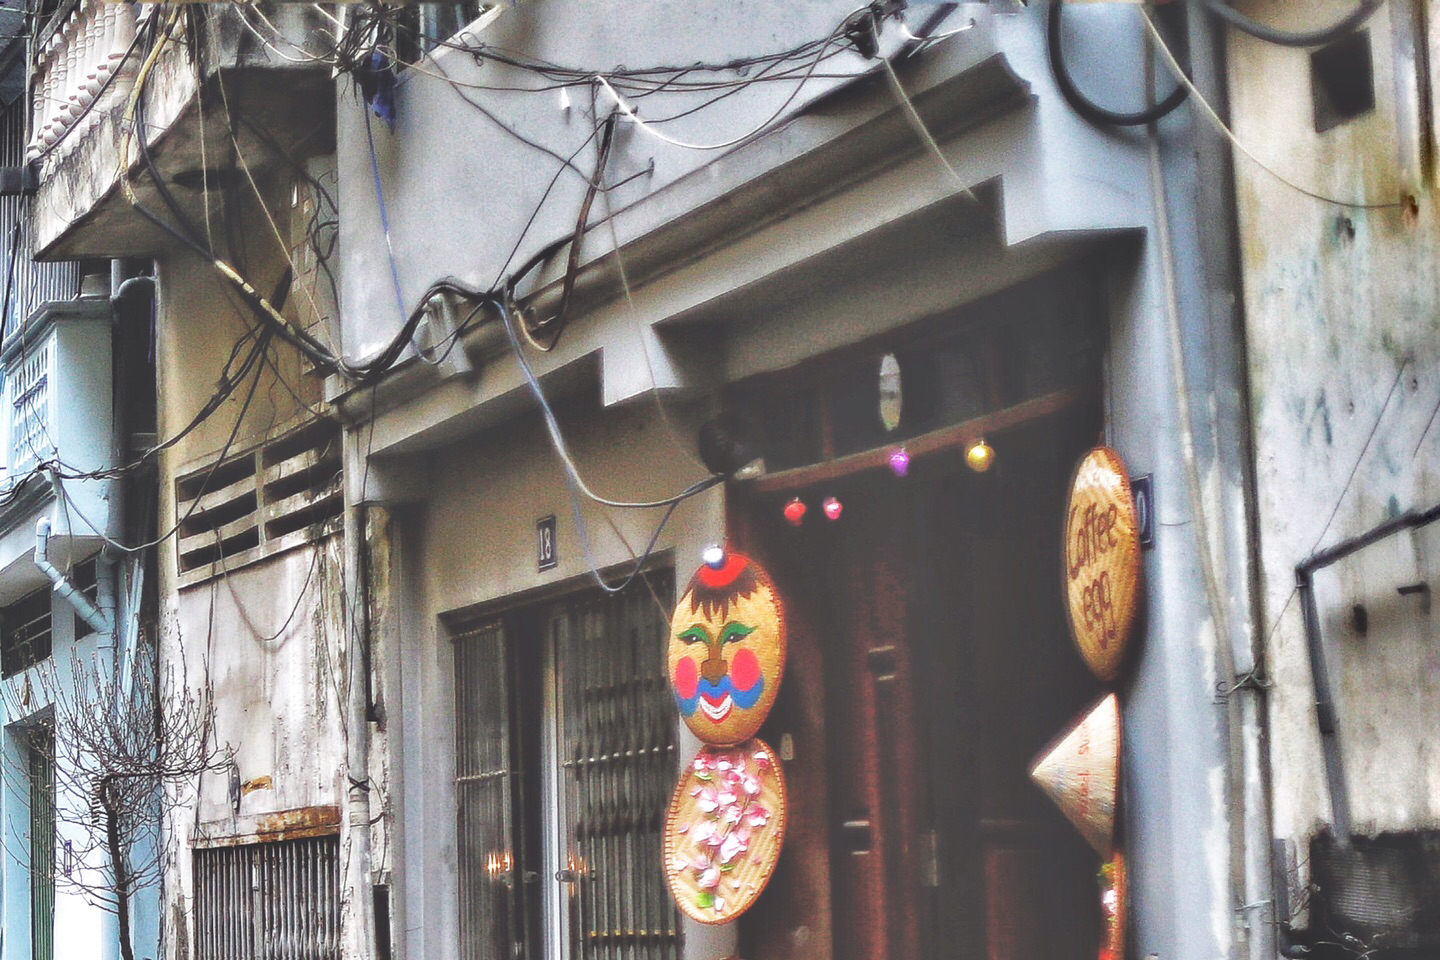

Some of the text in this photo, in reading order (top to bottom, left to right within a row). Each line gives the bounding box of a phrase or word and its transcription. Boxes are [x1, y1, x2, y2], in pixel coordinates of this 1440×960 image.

[539, 527, 551, 560] 18
[1068, 502, 1117, 580] Coffee
[1083, 570, 1116, 650] egg
